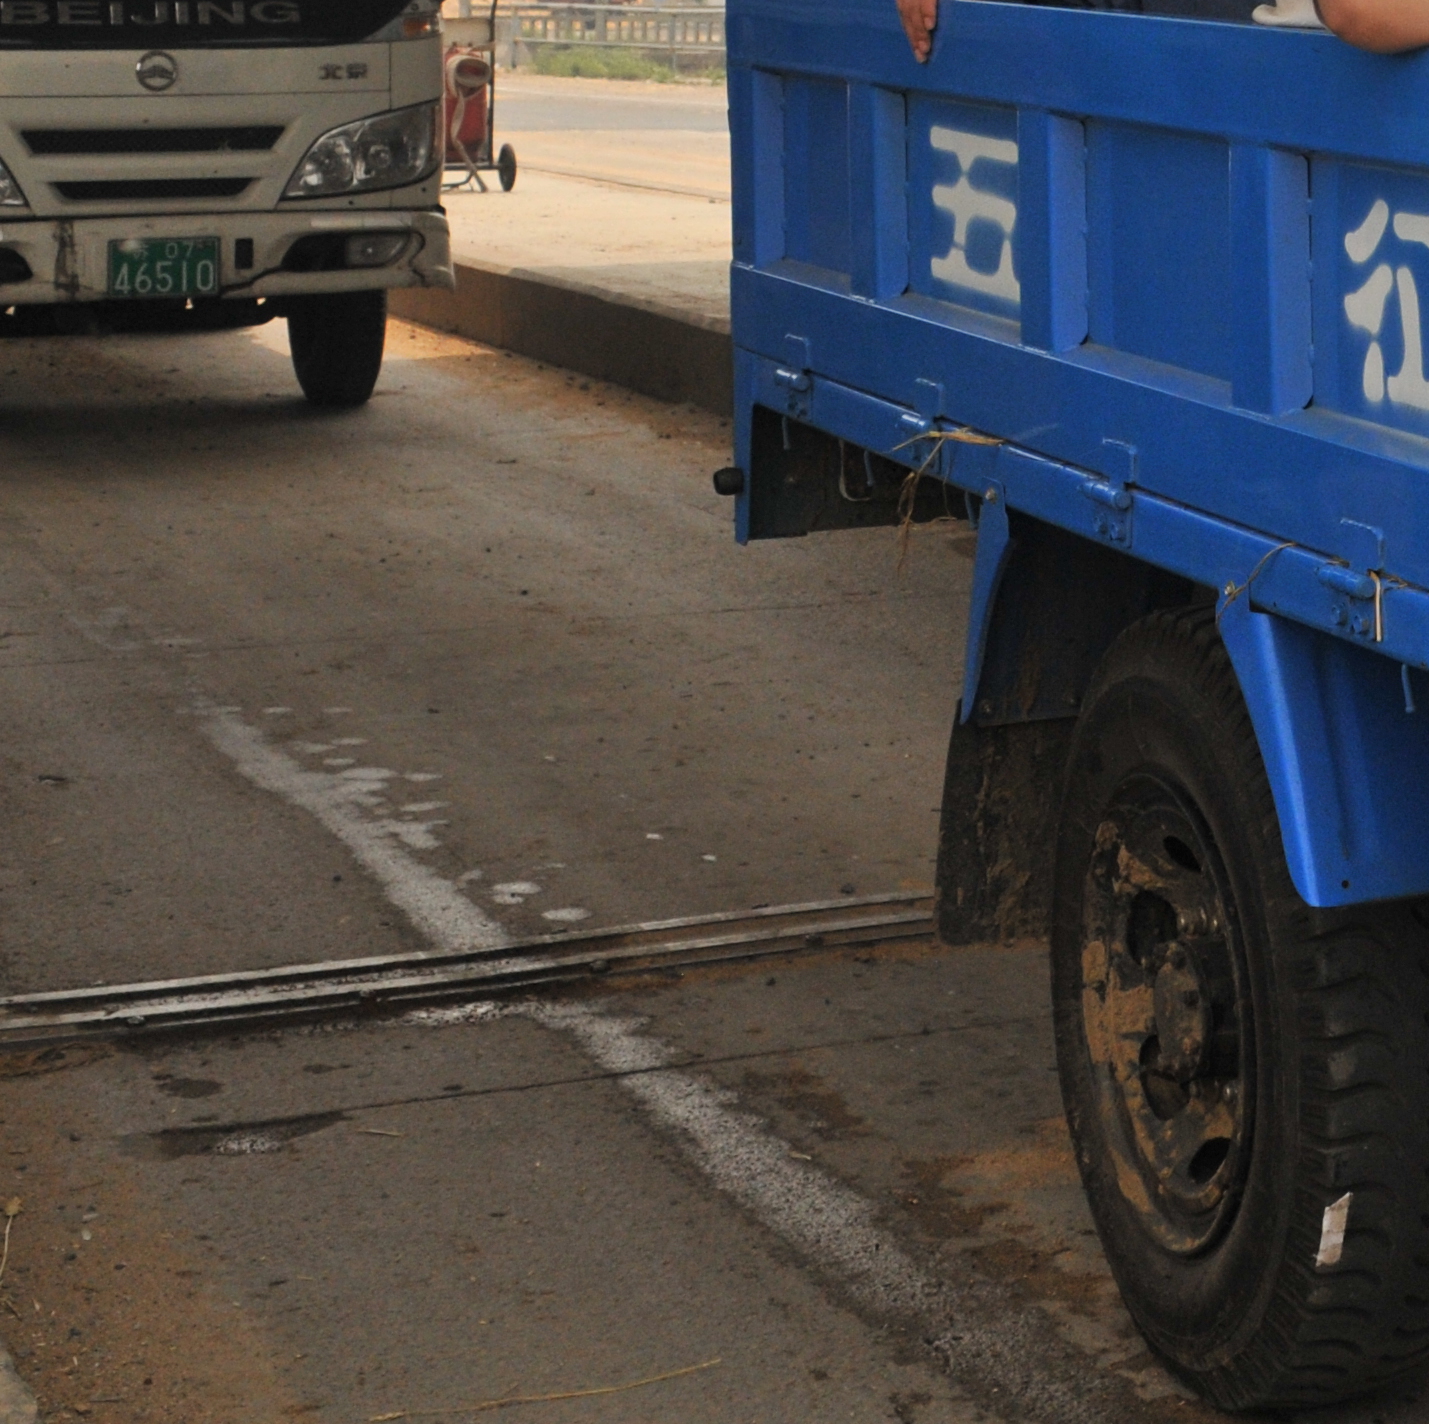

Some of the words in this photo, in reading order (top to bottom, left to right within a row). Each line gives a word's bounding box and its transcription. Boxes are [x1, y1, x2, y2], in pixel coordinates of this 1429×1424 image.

[0, 0, 301, 26] BEIJING
[929, 124, 1021, 304] 五
[114, 258, 215, 294] 46510
